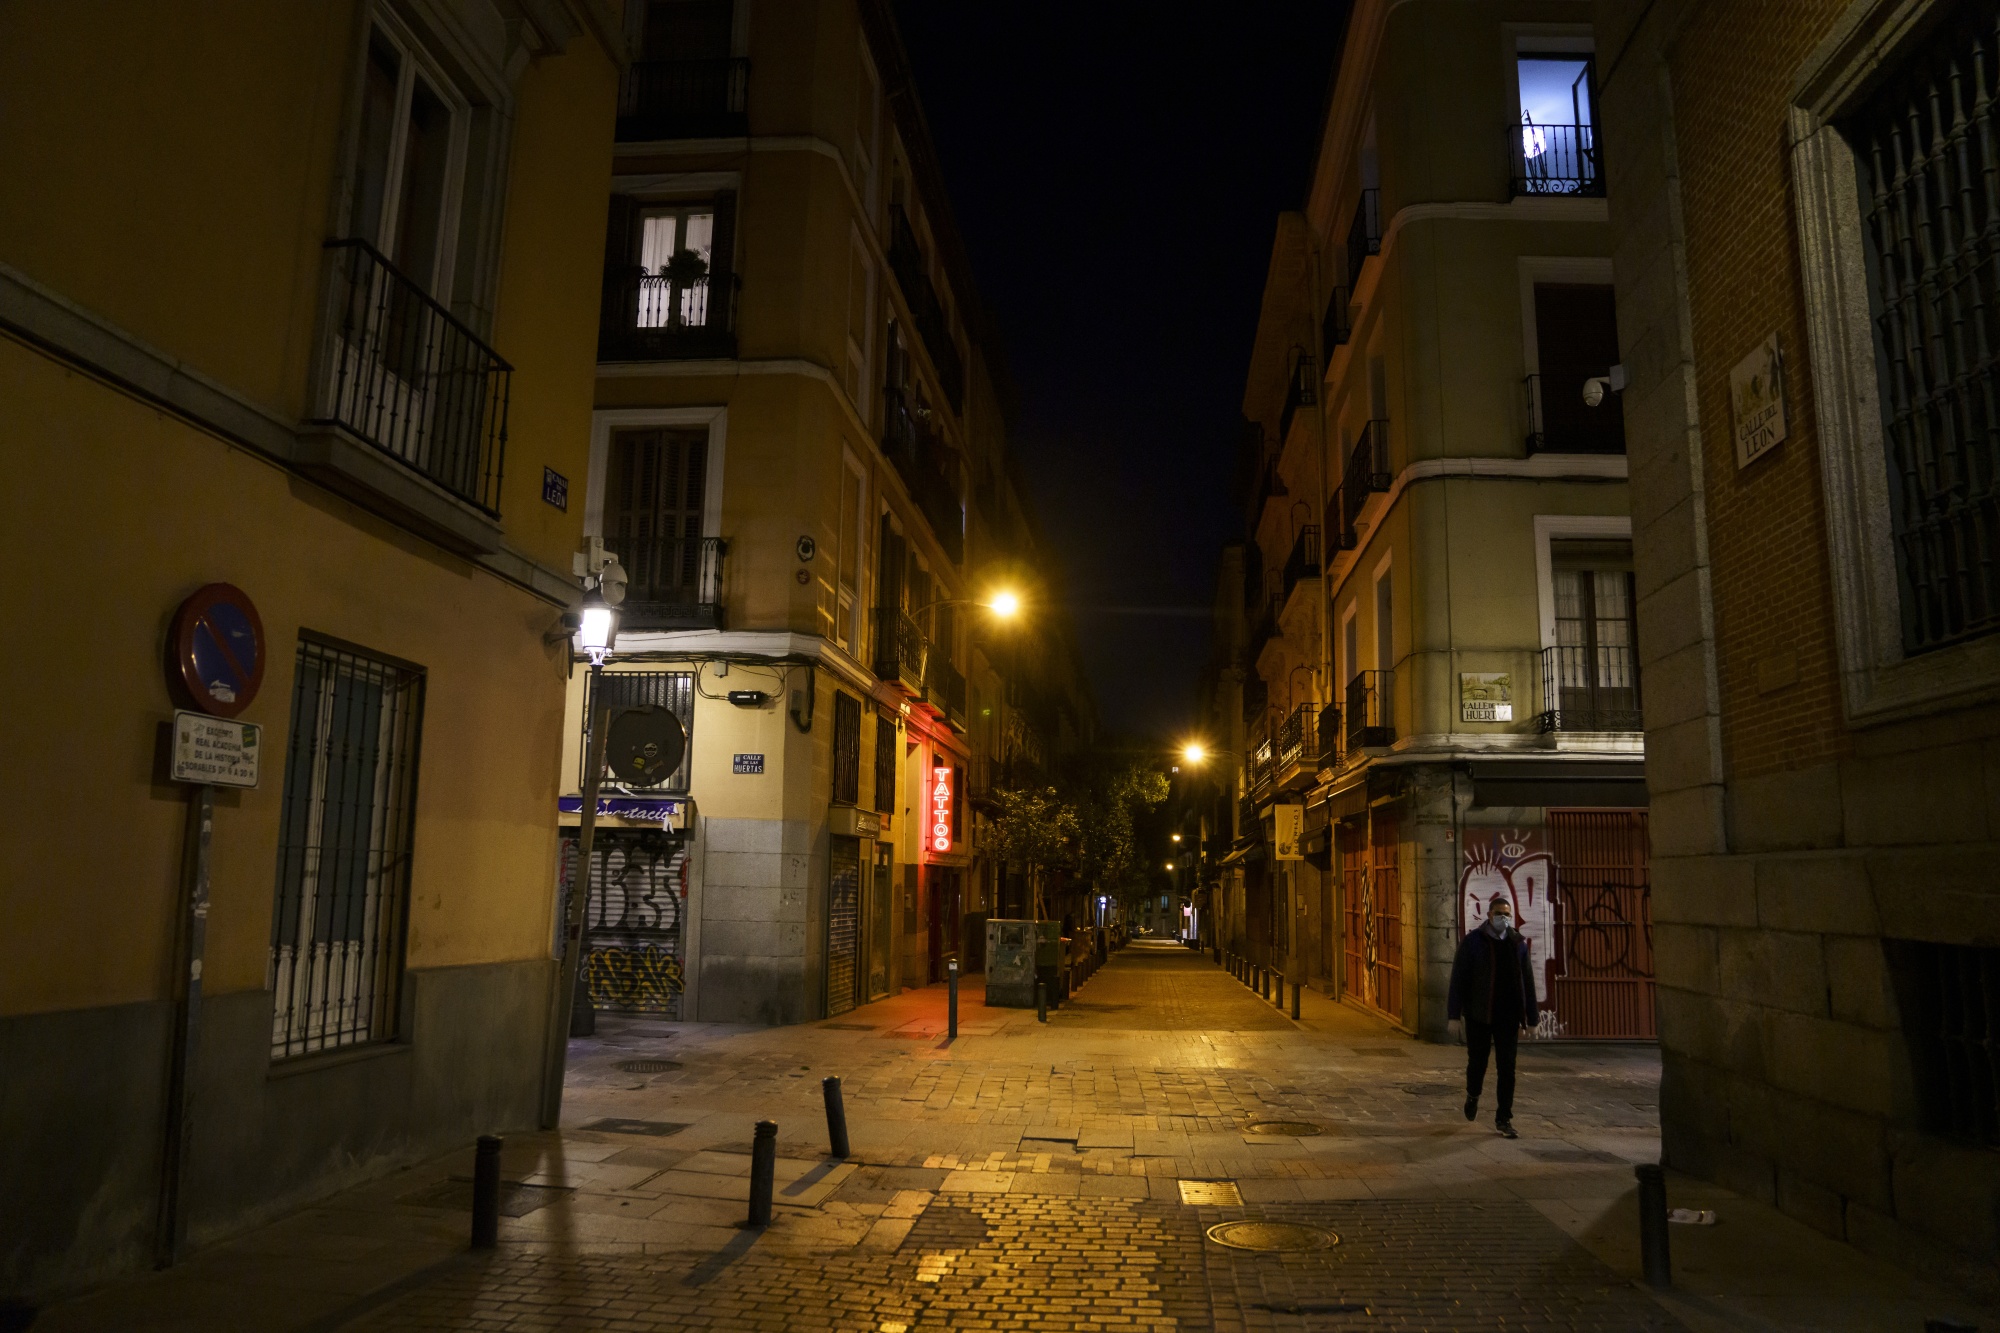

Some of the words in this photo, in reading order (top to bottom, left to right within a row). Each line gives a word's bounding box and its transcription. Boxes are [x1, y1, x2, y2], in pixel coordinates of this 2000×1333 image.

[1739, 411, 1765, 441] CALLE
[1463, 702, 1488, 710] CALLE
[1466, 710, 1498, 720] HUERT
[195, 737, 210, 748] REAL
[212, 741, 241, 752] ACADEMIA
[194, 750, 203, 759] DE
[205, 752, 213, 760] LA
[734, 764, 763, 773] HUERTAS
[933, 768, 950, 850] TATTOO
